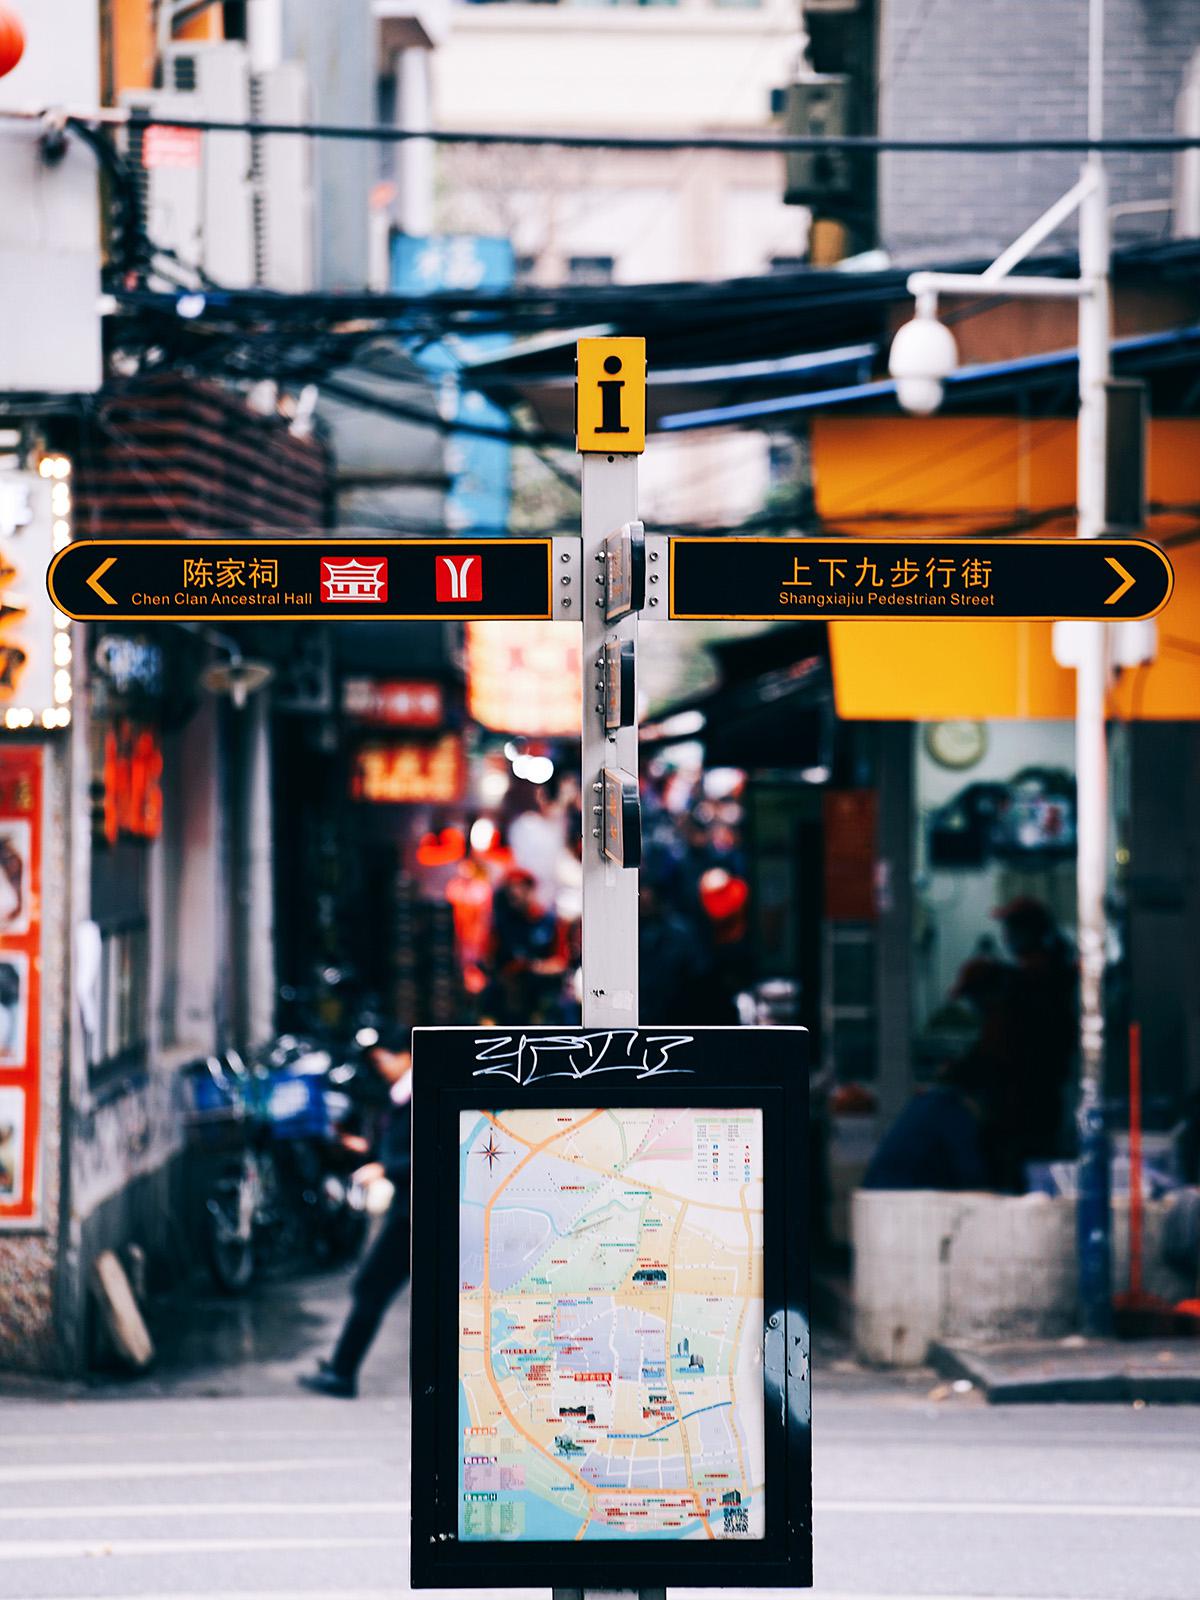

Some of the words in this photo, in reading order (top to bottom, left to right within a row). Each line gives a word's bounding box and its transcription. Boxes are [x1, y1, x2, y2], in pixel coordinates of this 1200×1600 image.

[594, 355, 630, 433] i
[183, 557, 278, 588] 陈家祠
[782, 556, 993, 589] 上下九步行街
[131, 592, 170, 605] Chen
[174, 592, 207, 605] Clan
[211, 592, 280, 605] Ancestral
[284, 592, 312, 605] Hall
[779, 592, 864, 607] Shangxiajiu
[868, 592, 946, 606] Pedestrian
[950, 592, 995, 606] Street
